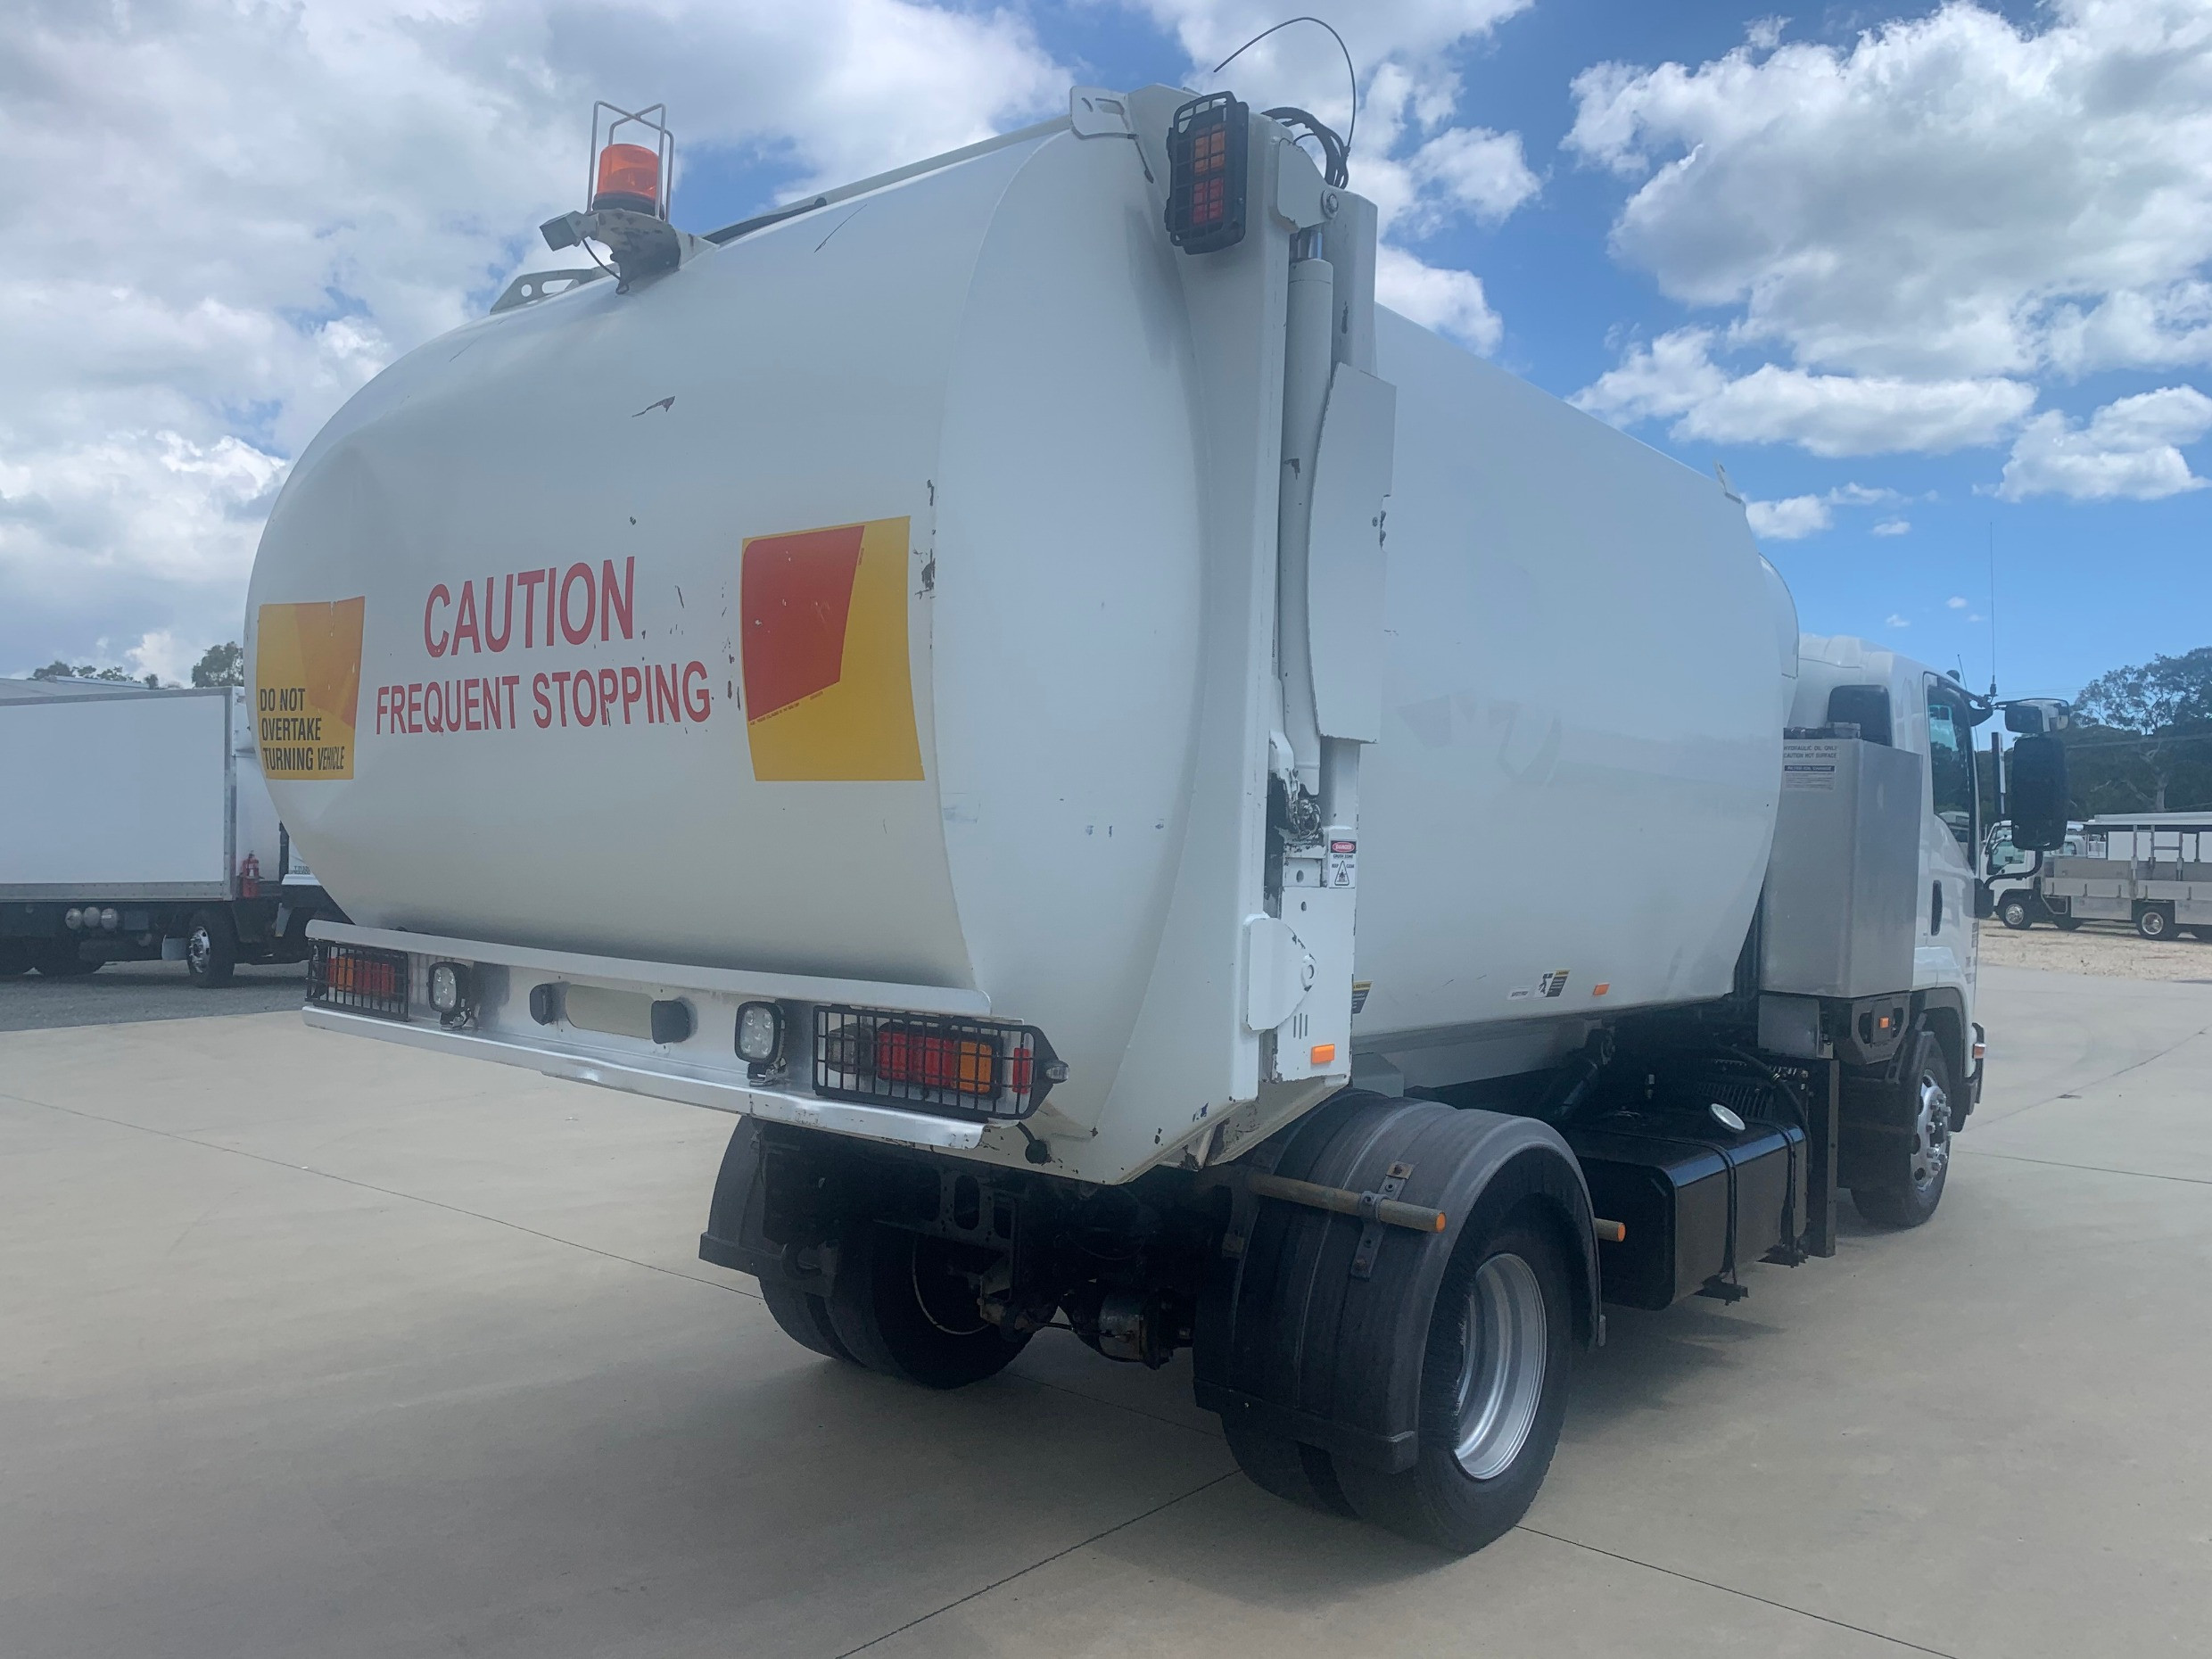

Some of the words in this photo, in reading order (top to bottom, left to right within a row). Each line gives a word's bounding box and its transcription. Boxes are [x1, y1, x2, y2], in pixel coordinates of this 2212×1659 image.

[424, 556, 635, 658] CAUTION
[260, 688, 276, 712] DO
[279, 688, 305, 712] NOT
[376, 674, 520, 735] FREQUENT
[532, 660, 712, 730] STOPPING
[261, 717, 322, 741] OVERTAKE
[263, 747, 314, 771] TURNING
[318, 746, 345, 771] VEHICLE
